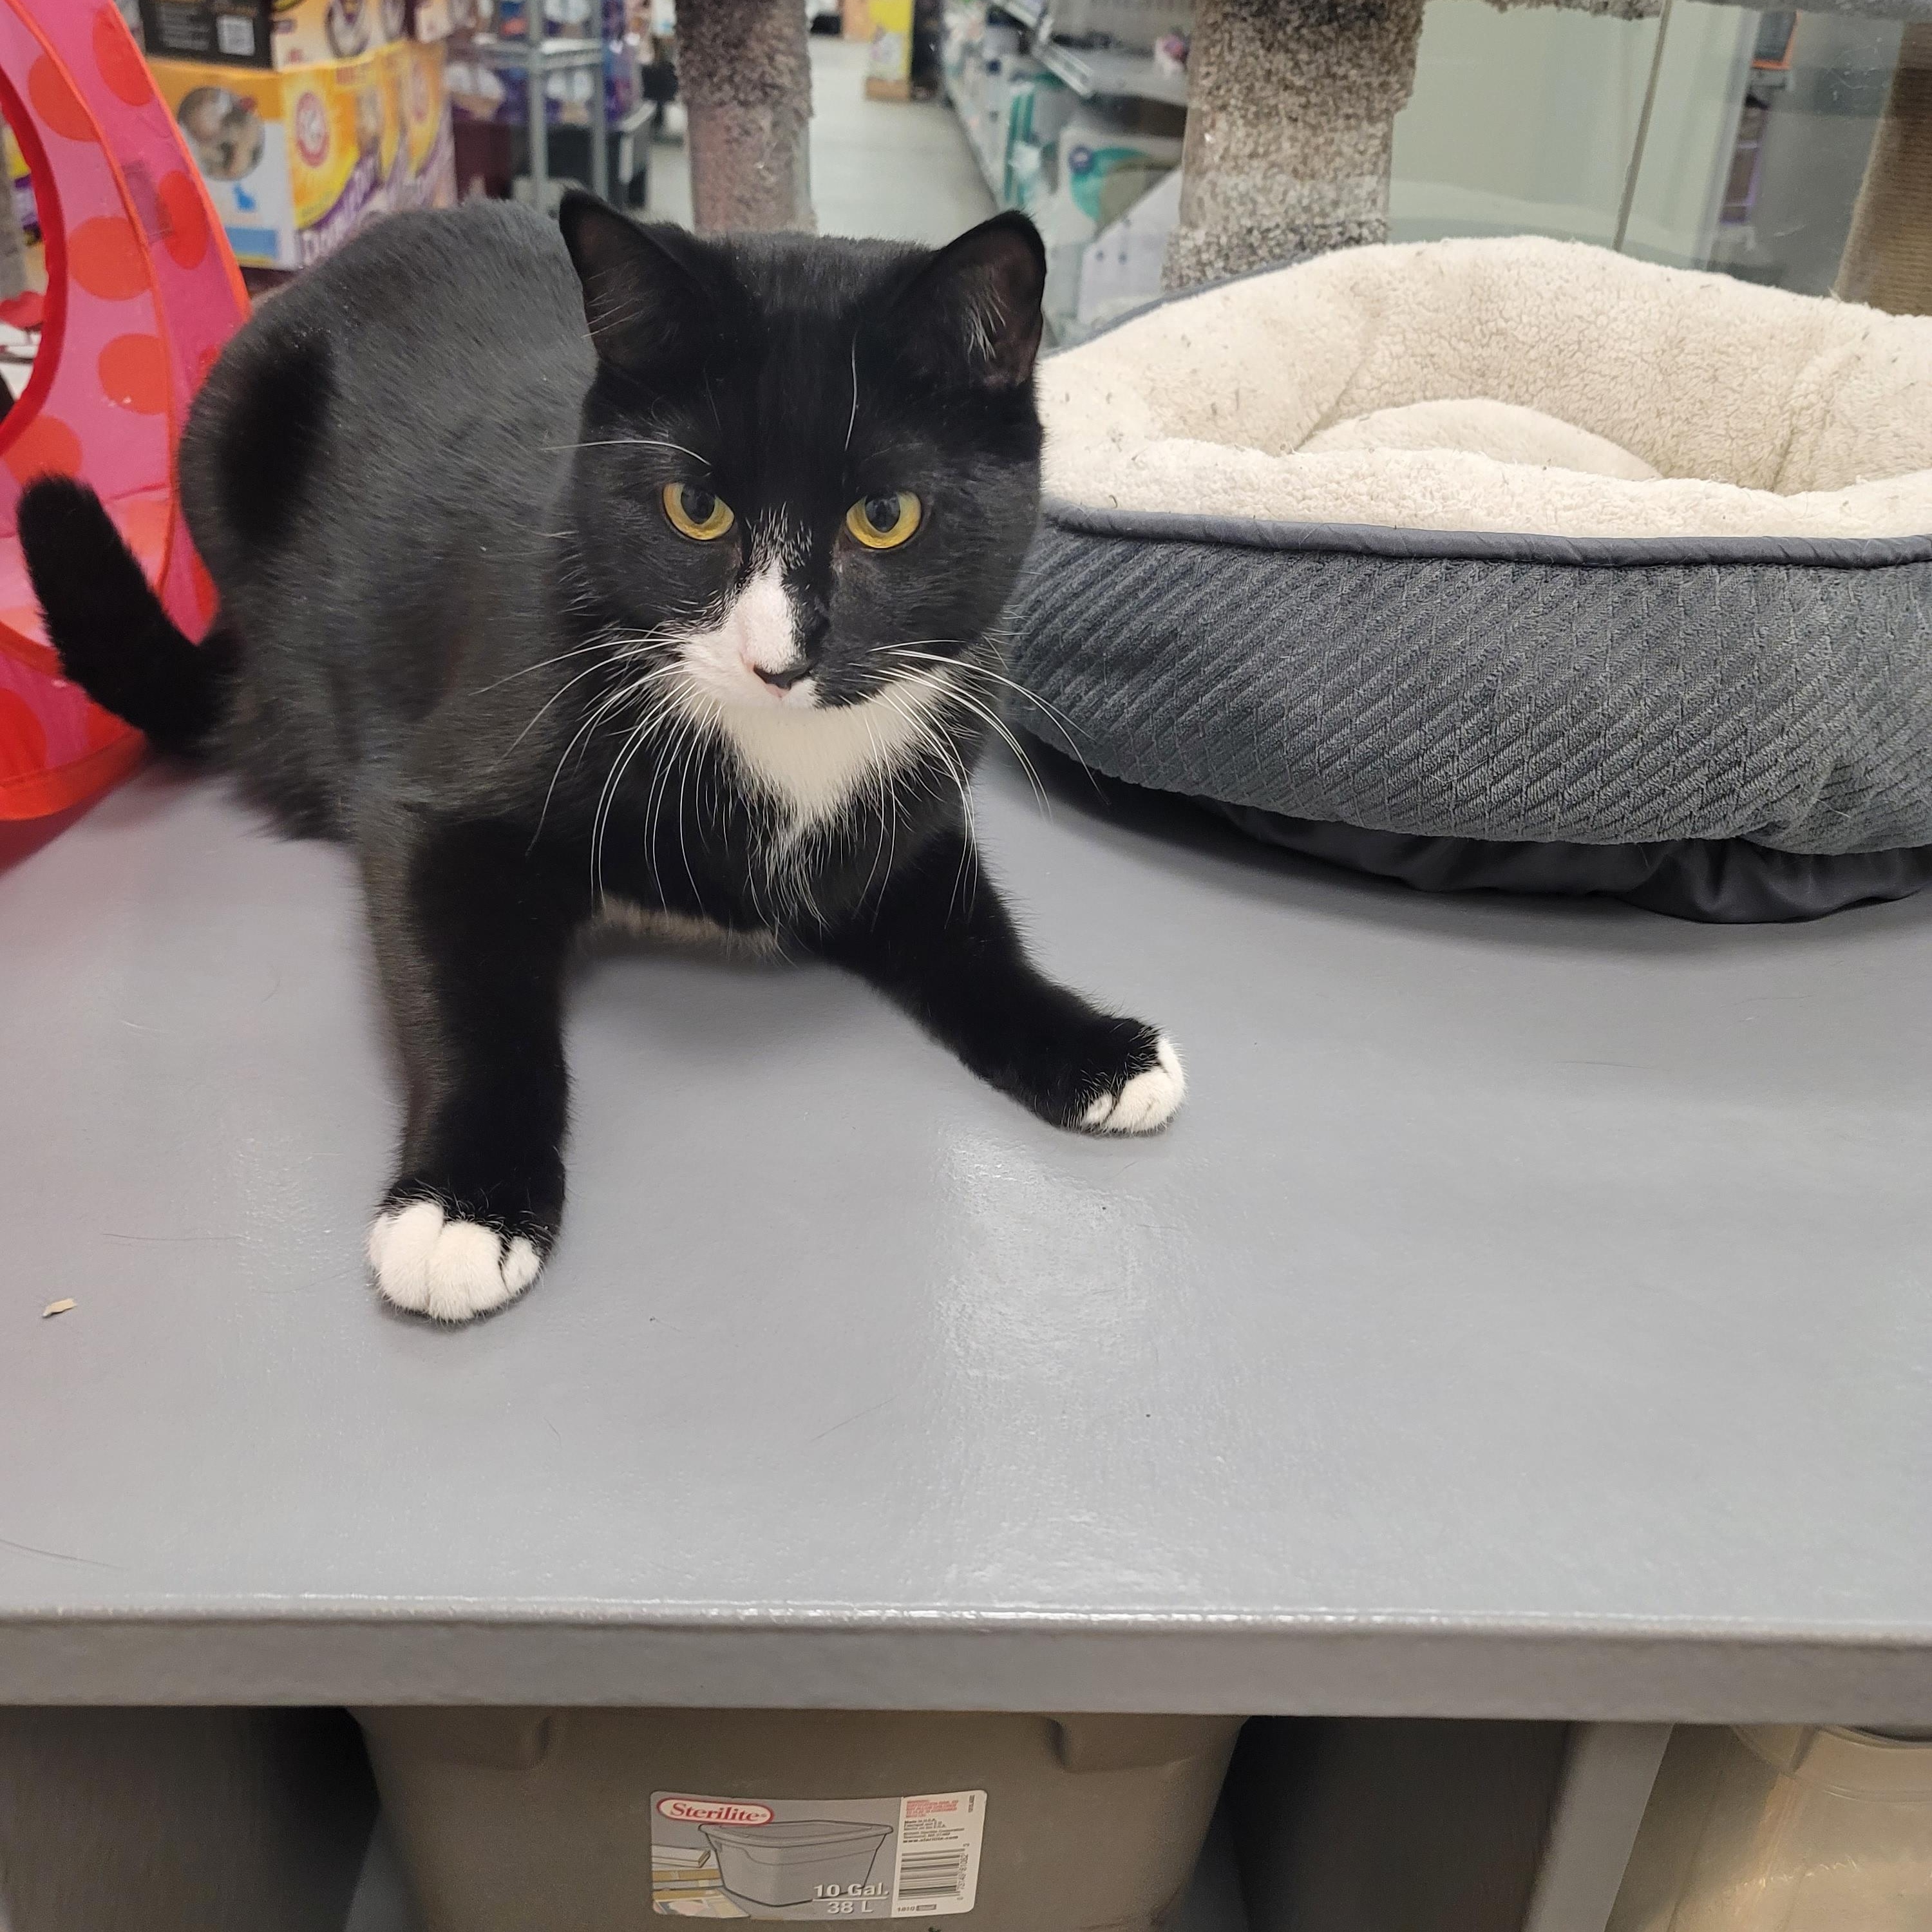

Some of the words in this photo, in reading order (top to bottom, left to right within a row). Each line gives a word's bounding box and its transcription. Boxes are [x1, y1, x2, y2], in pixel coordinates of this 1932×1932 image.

[670, 1803, 760, 1822] Sterilite
[813, 1884, 841, 1897] 10
[848, 1882, 889, 1896] Gal.
[827, 1900, 855, 1914] 38
[861, 1900, 874, 1913] L
